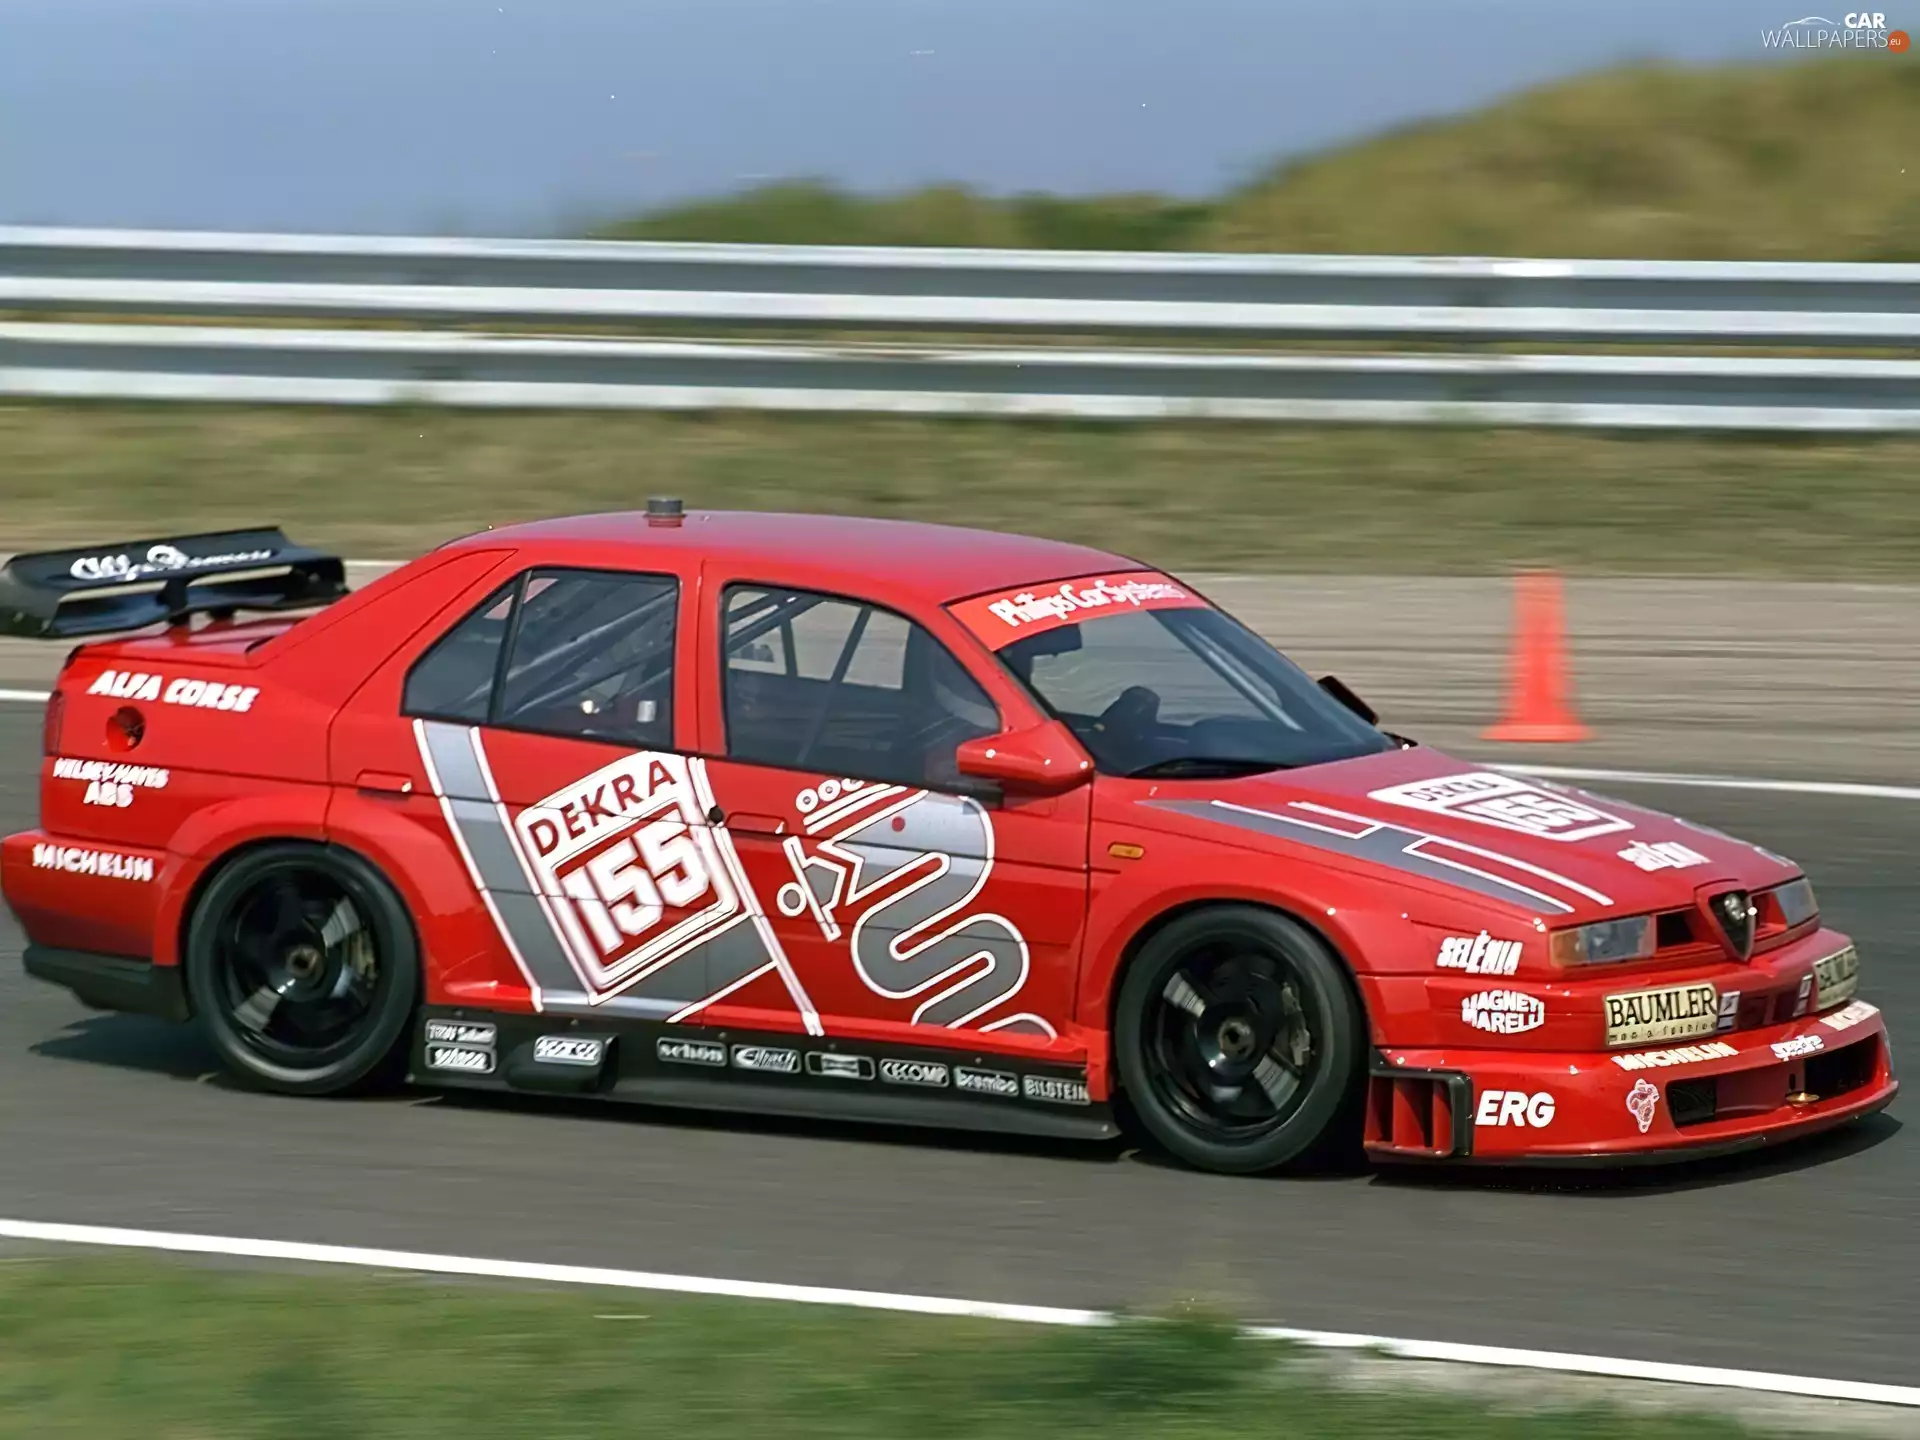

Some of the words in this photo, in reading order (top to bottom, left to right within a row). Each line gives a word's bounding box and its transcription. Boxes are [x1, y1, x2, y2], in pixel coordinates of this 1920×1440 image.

[86, 670, 163, 701] ALFA
[162, 678, 261, 712] CORSE
[527, 759, 677, 858] DEKRA
[32, 842, 155, 882] MICHELIN
[559, 807, 710, 956] 155
[1611, 1041, 1740, 1071] MICHELIN
[1475, 1090, 1556, 1128] ERG
